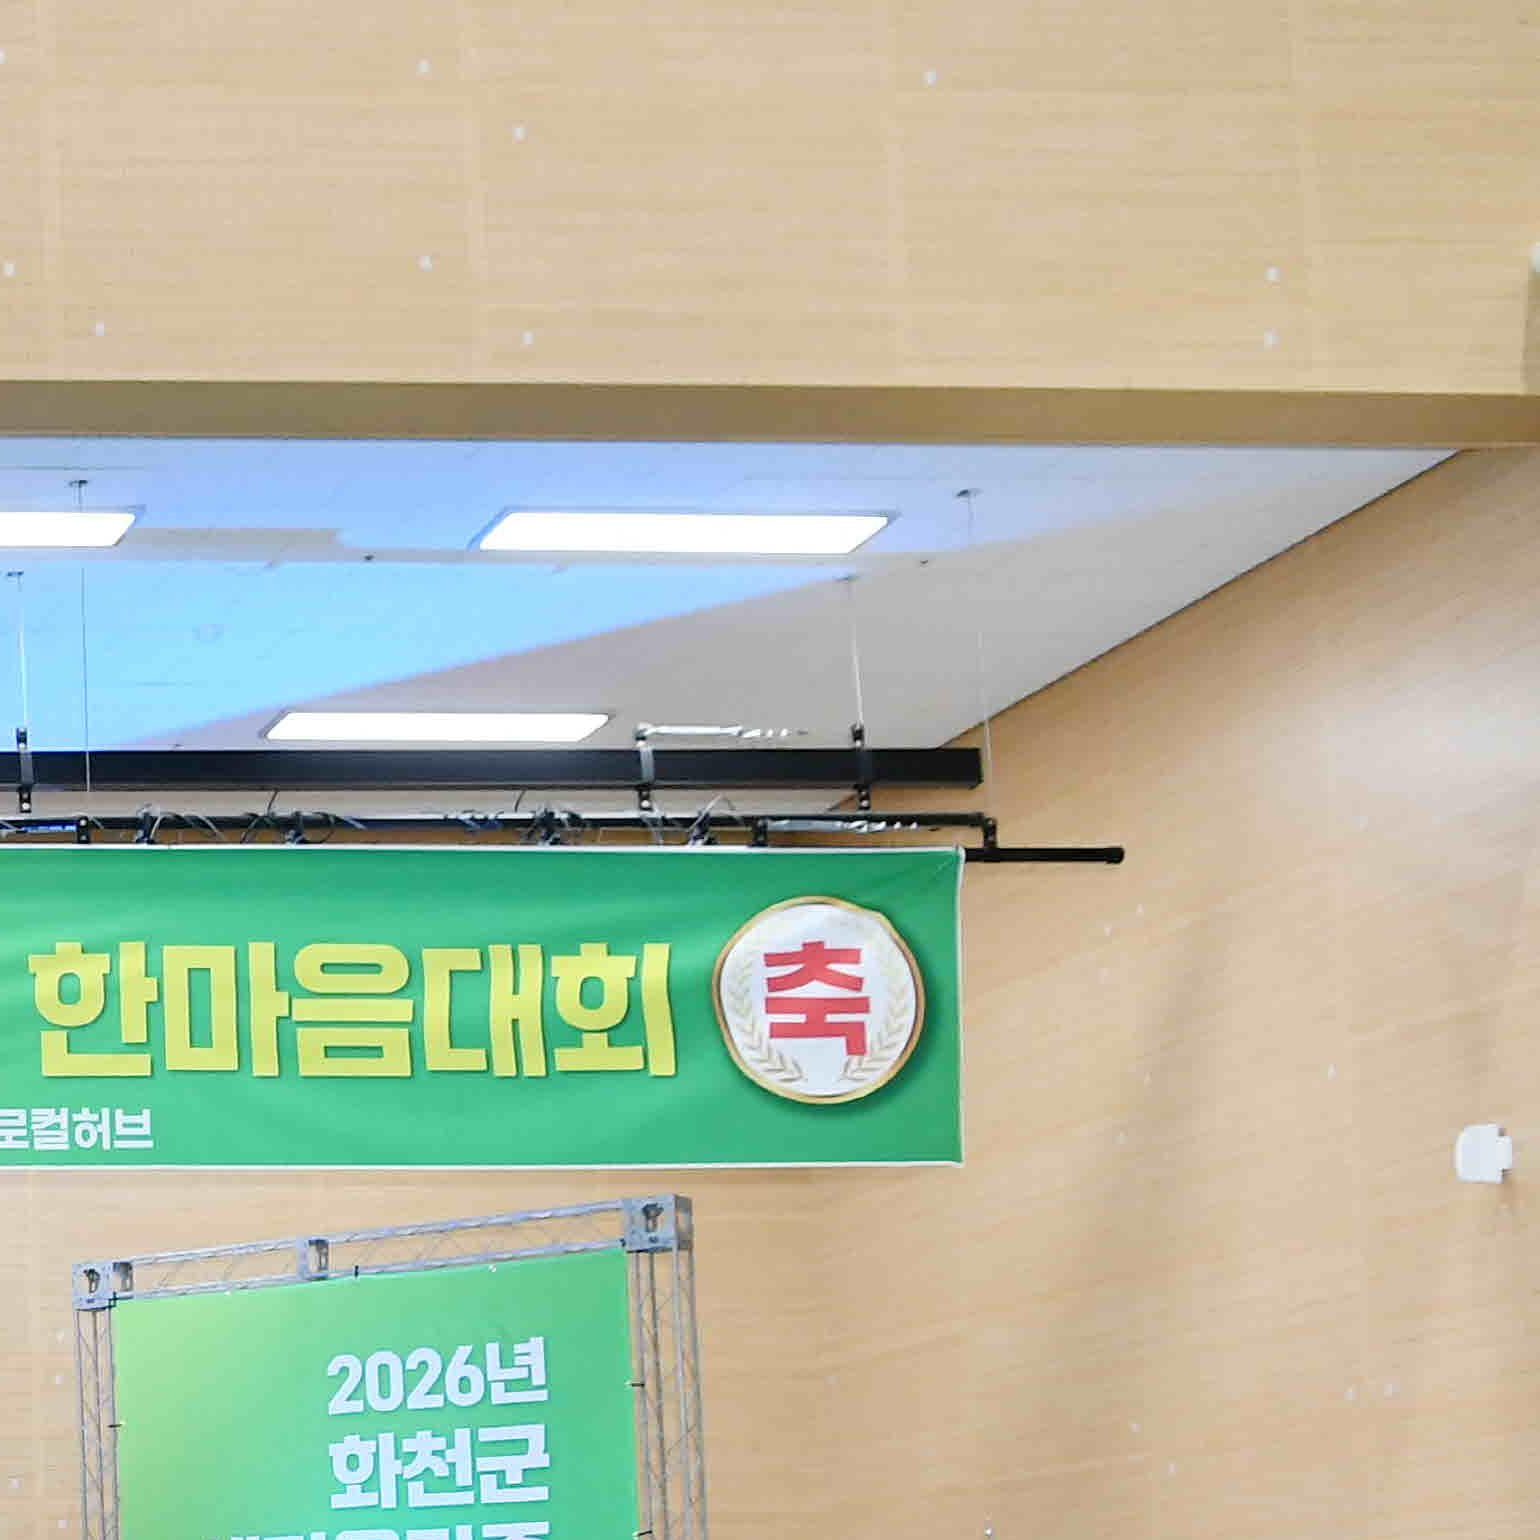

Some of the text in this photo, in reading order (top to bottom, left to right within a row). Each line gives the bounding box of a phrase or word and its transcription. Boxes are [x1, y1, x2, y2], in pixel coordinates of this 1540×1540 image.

[27, 940, 676, 1078] 한마음대회
[763, 939, 869, 1057] 축
[326, 1335, 550, 1416] 2026년
[328, 1423, 551, 1510] 화천군
